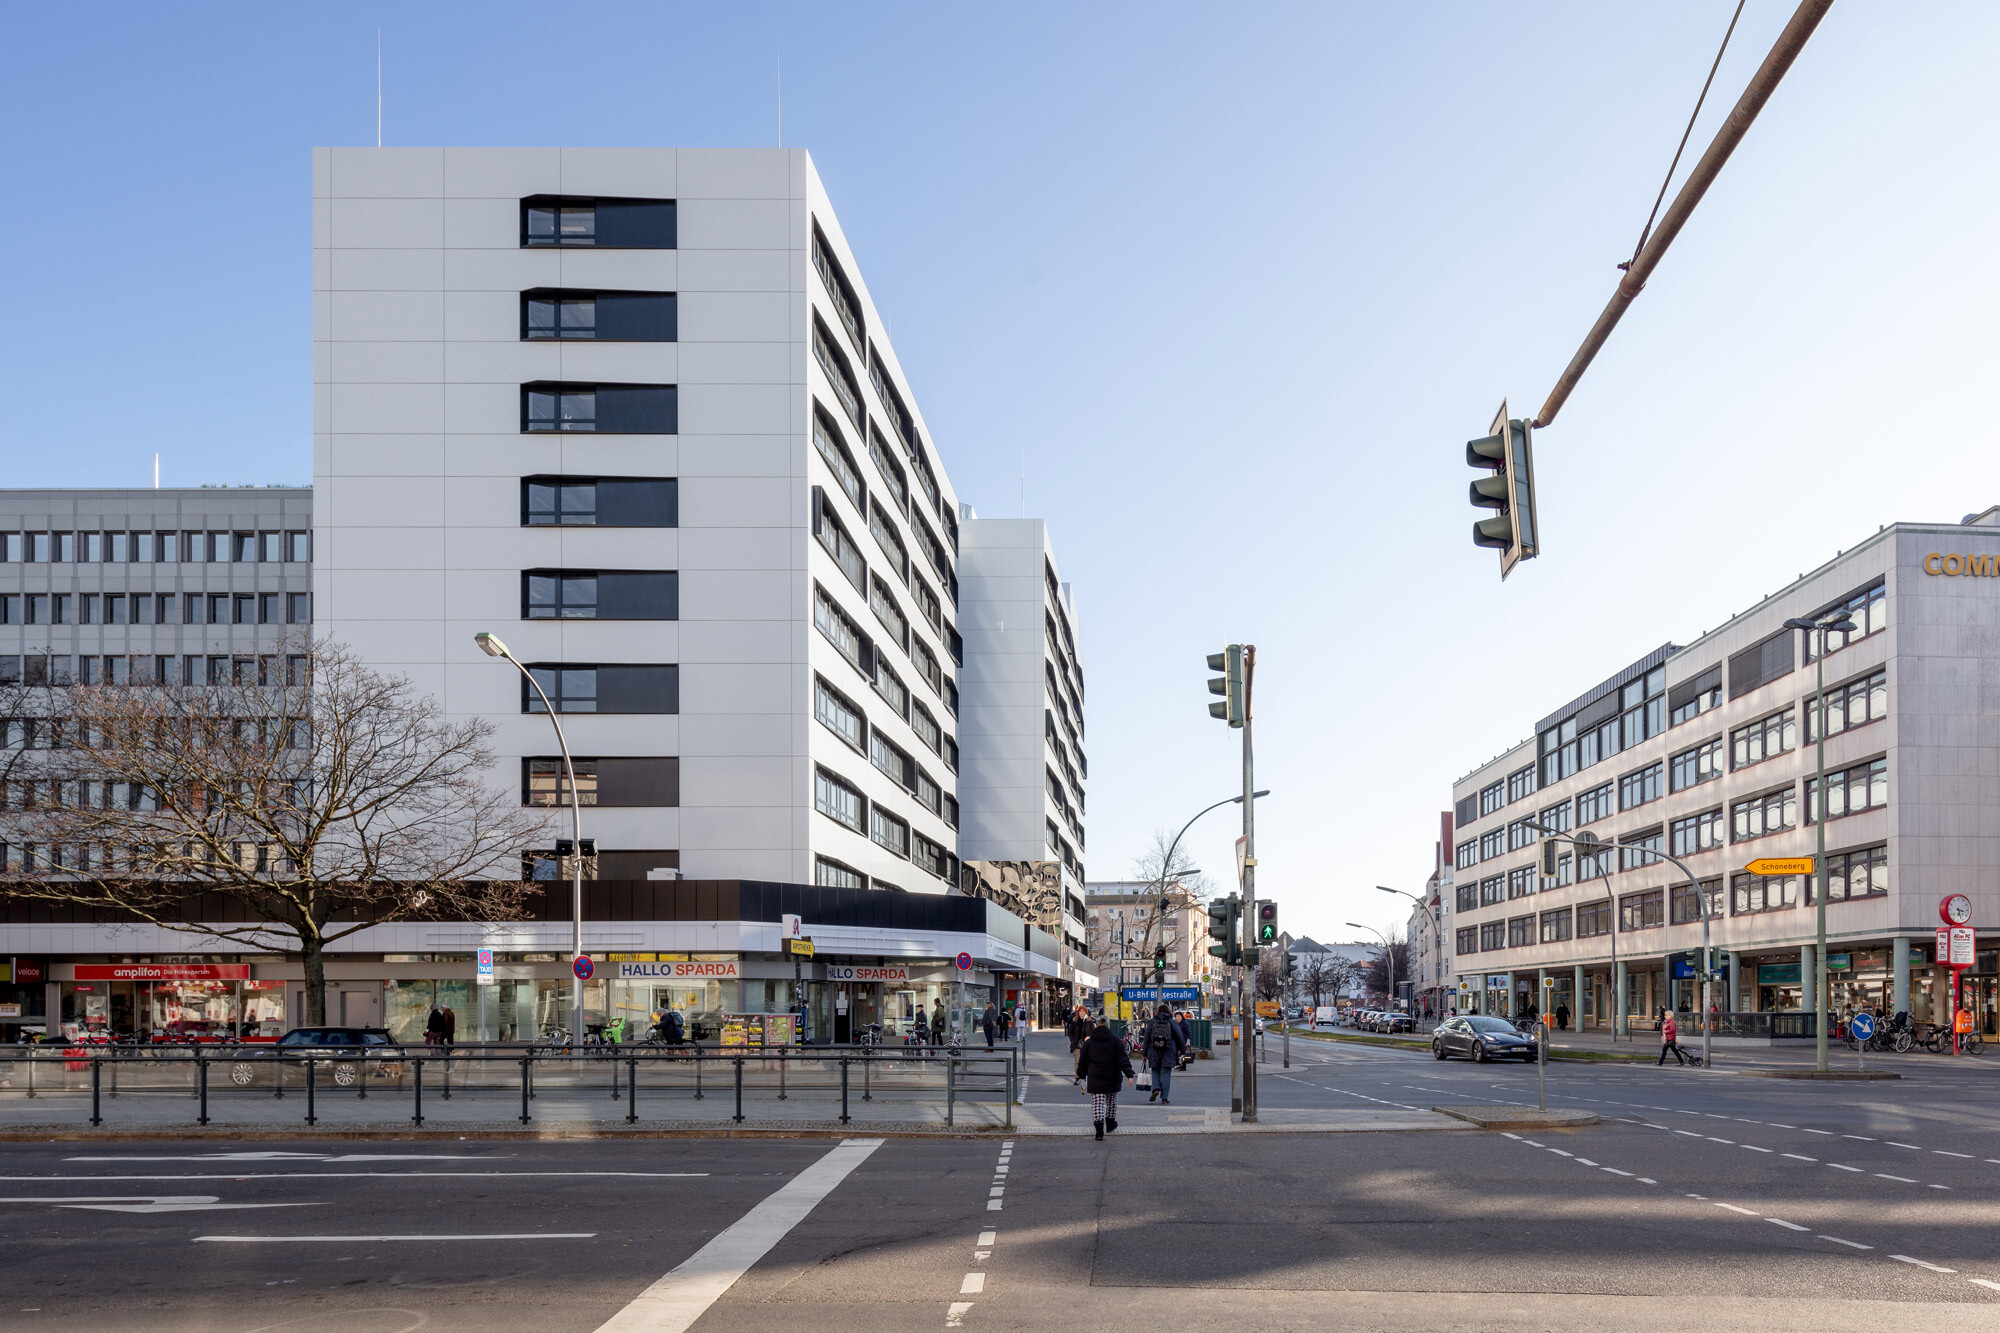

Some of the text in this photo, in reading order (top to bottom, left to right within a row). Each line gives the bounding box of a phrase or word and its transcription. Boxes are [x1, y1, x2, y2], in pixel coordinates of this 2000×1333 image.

[1761, 863, 1805, 871] Schöneberg
[793, 942, 811, 952] APOTHEKE
[17, 967, 40, 976] veloce
[113, 966, 161, 979] amplifon
[622, 963, 737, 976] HALLO SPARDA
[827, 967, 907, 980] HALLO SPARDA
[1128, 990, 1192, 999] U-Bhf Blsestraße
